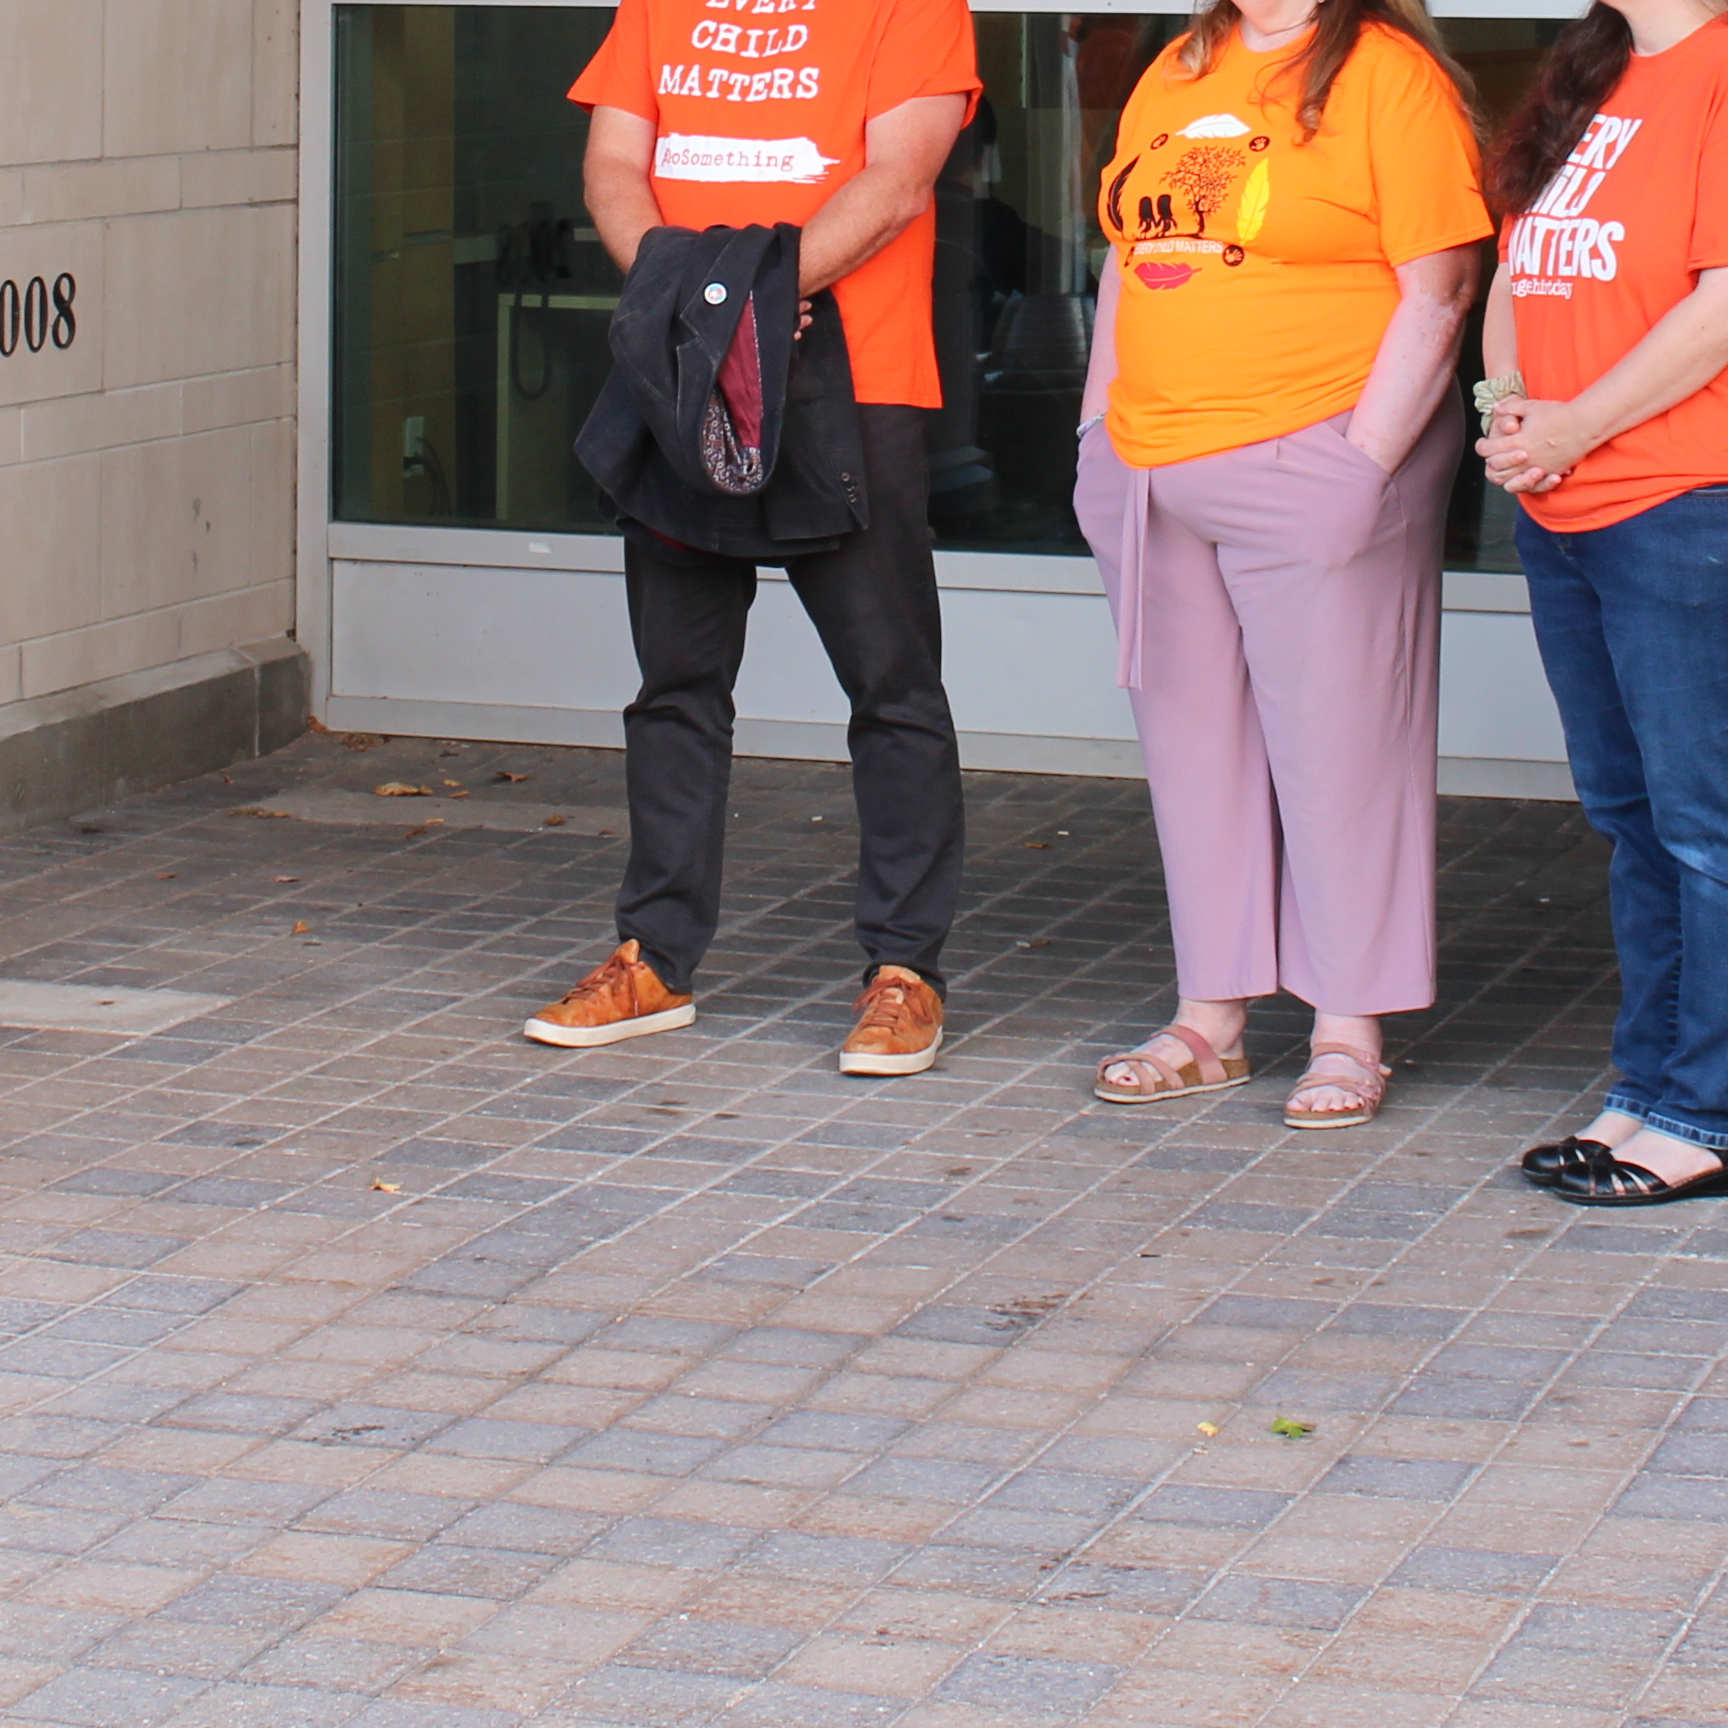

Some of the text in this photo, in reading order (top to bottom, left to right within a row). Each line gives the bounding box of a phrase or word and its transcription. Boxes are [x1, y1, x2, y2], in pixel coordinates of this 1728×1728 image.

[691, 20, 809, 58] CHILD
[658, 64, 820, 102] MATTERS
[1176, 239, 1224, 254] MATTERS
